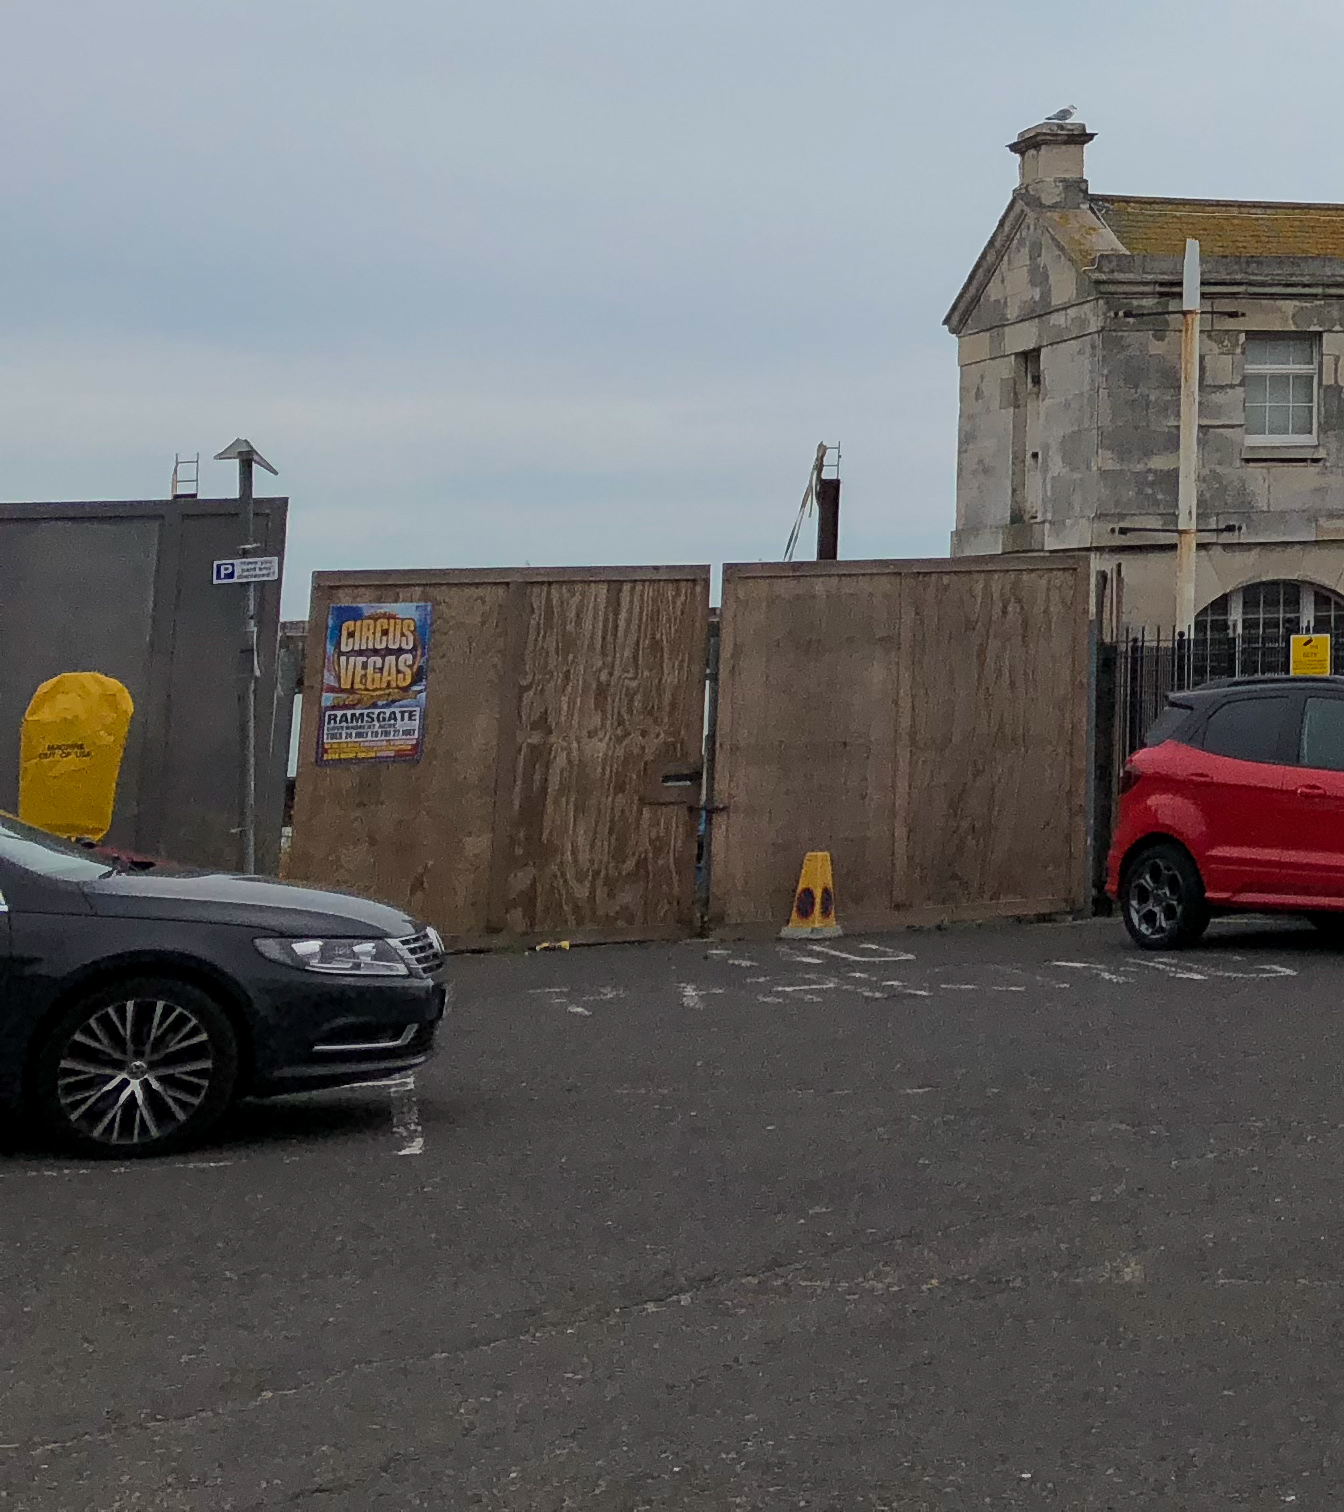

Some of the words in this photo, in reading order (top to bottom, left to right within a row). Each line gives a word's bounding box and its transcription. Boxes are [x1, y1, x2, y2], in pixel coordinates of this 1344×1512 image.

[220, 564, 233, 579] P
[340, 617, 415, 653] CIRCUS
[339, 653, 413, 690] VEGAS
[326, 709, 418, 726] RAMSGATE
